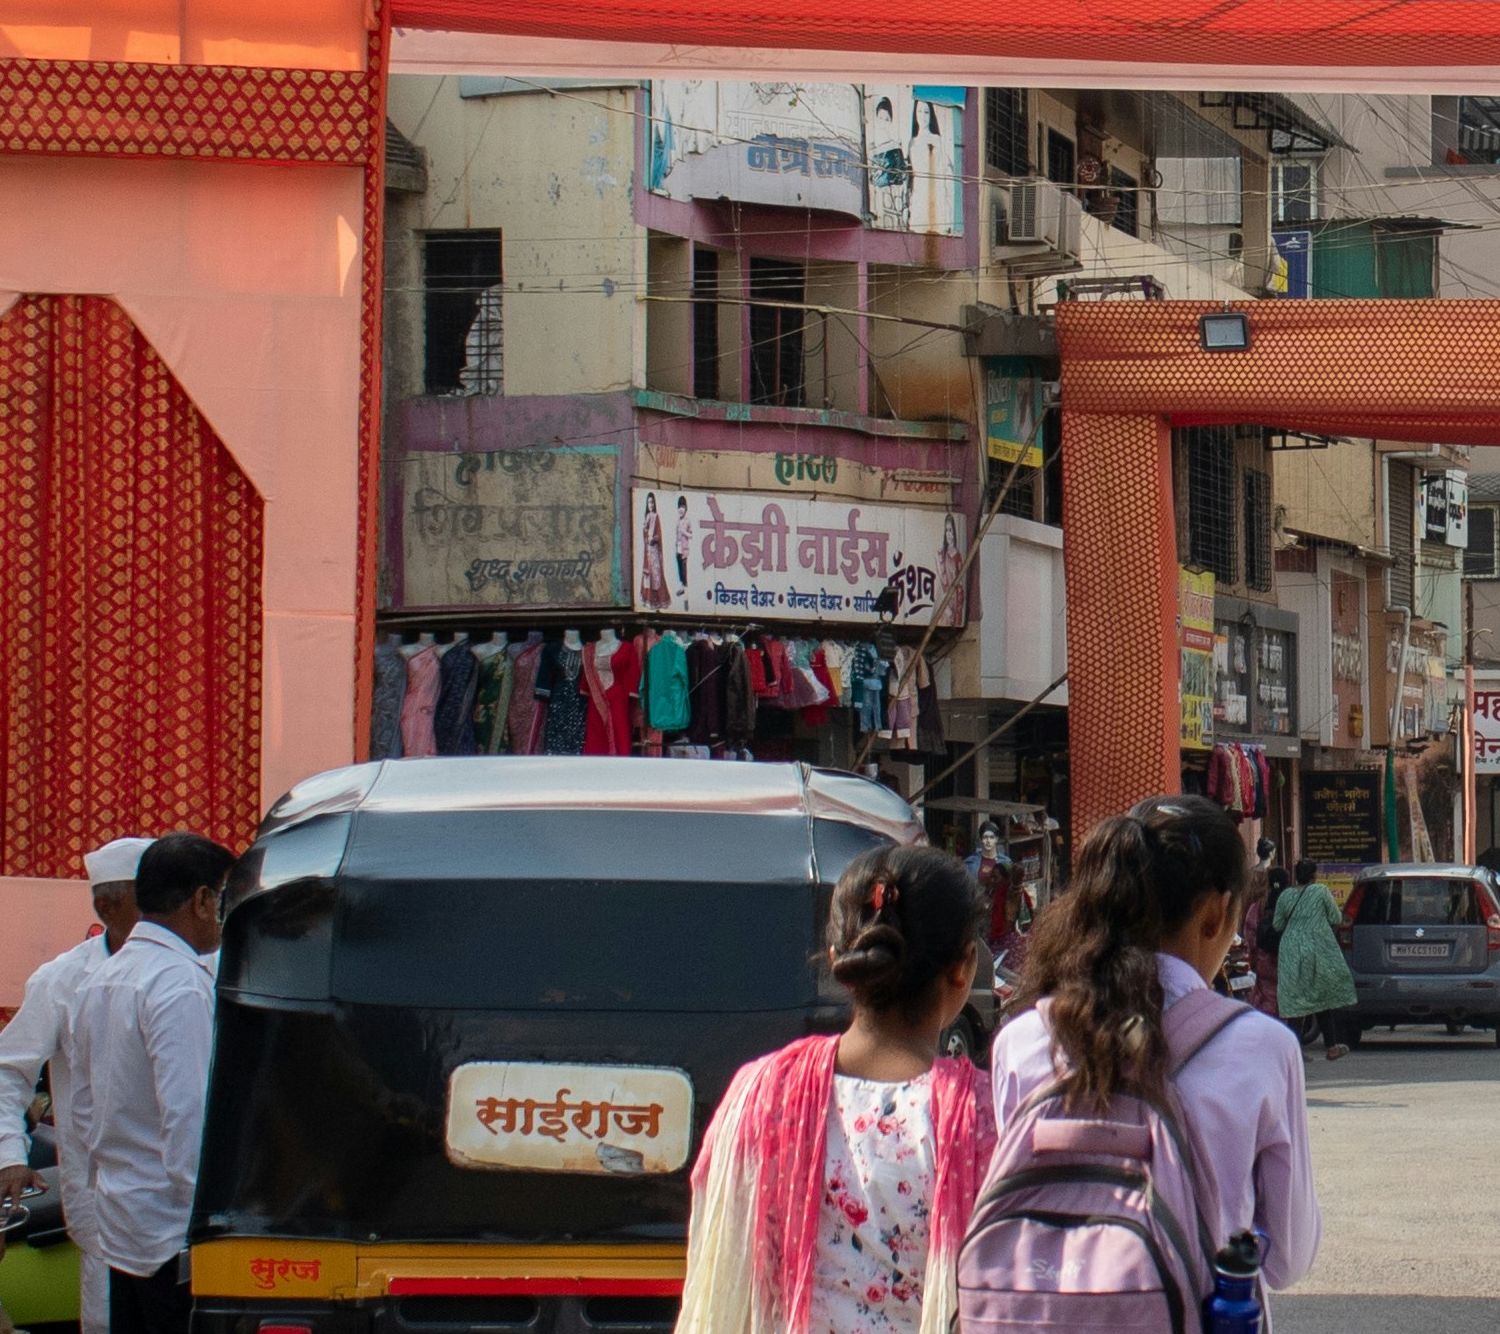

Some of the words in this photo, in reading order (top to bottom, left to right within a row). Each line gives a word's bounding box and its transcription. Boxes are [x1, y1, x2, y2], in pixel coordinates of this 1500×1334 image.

[700, 497, 791, 572] क्रेझी
[797, 509, 890, 582] नाईस
[475, 1087, 663, 1143] साईराज
[249, 1258, 321, 1290] सुरज
